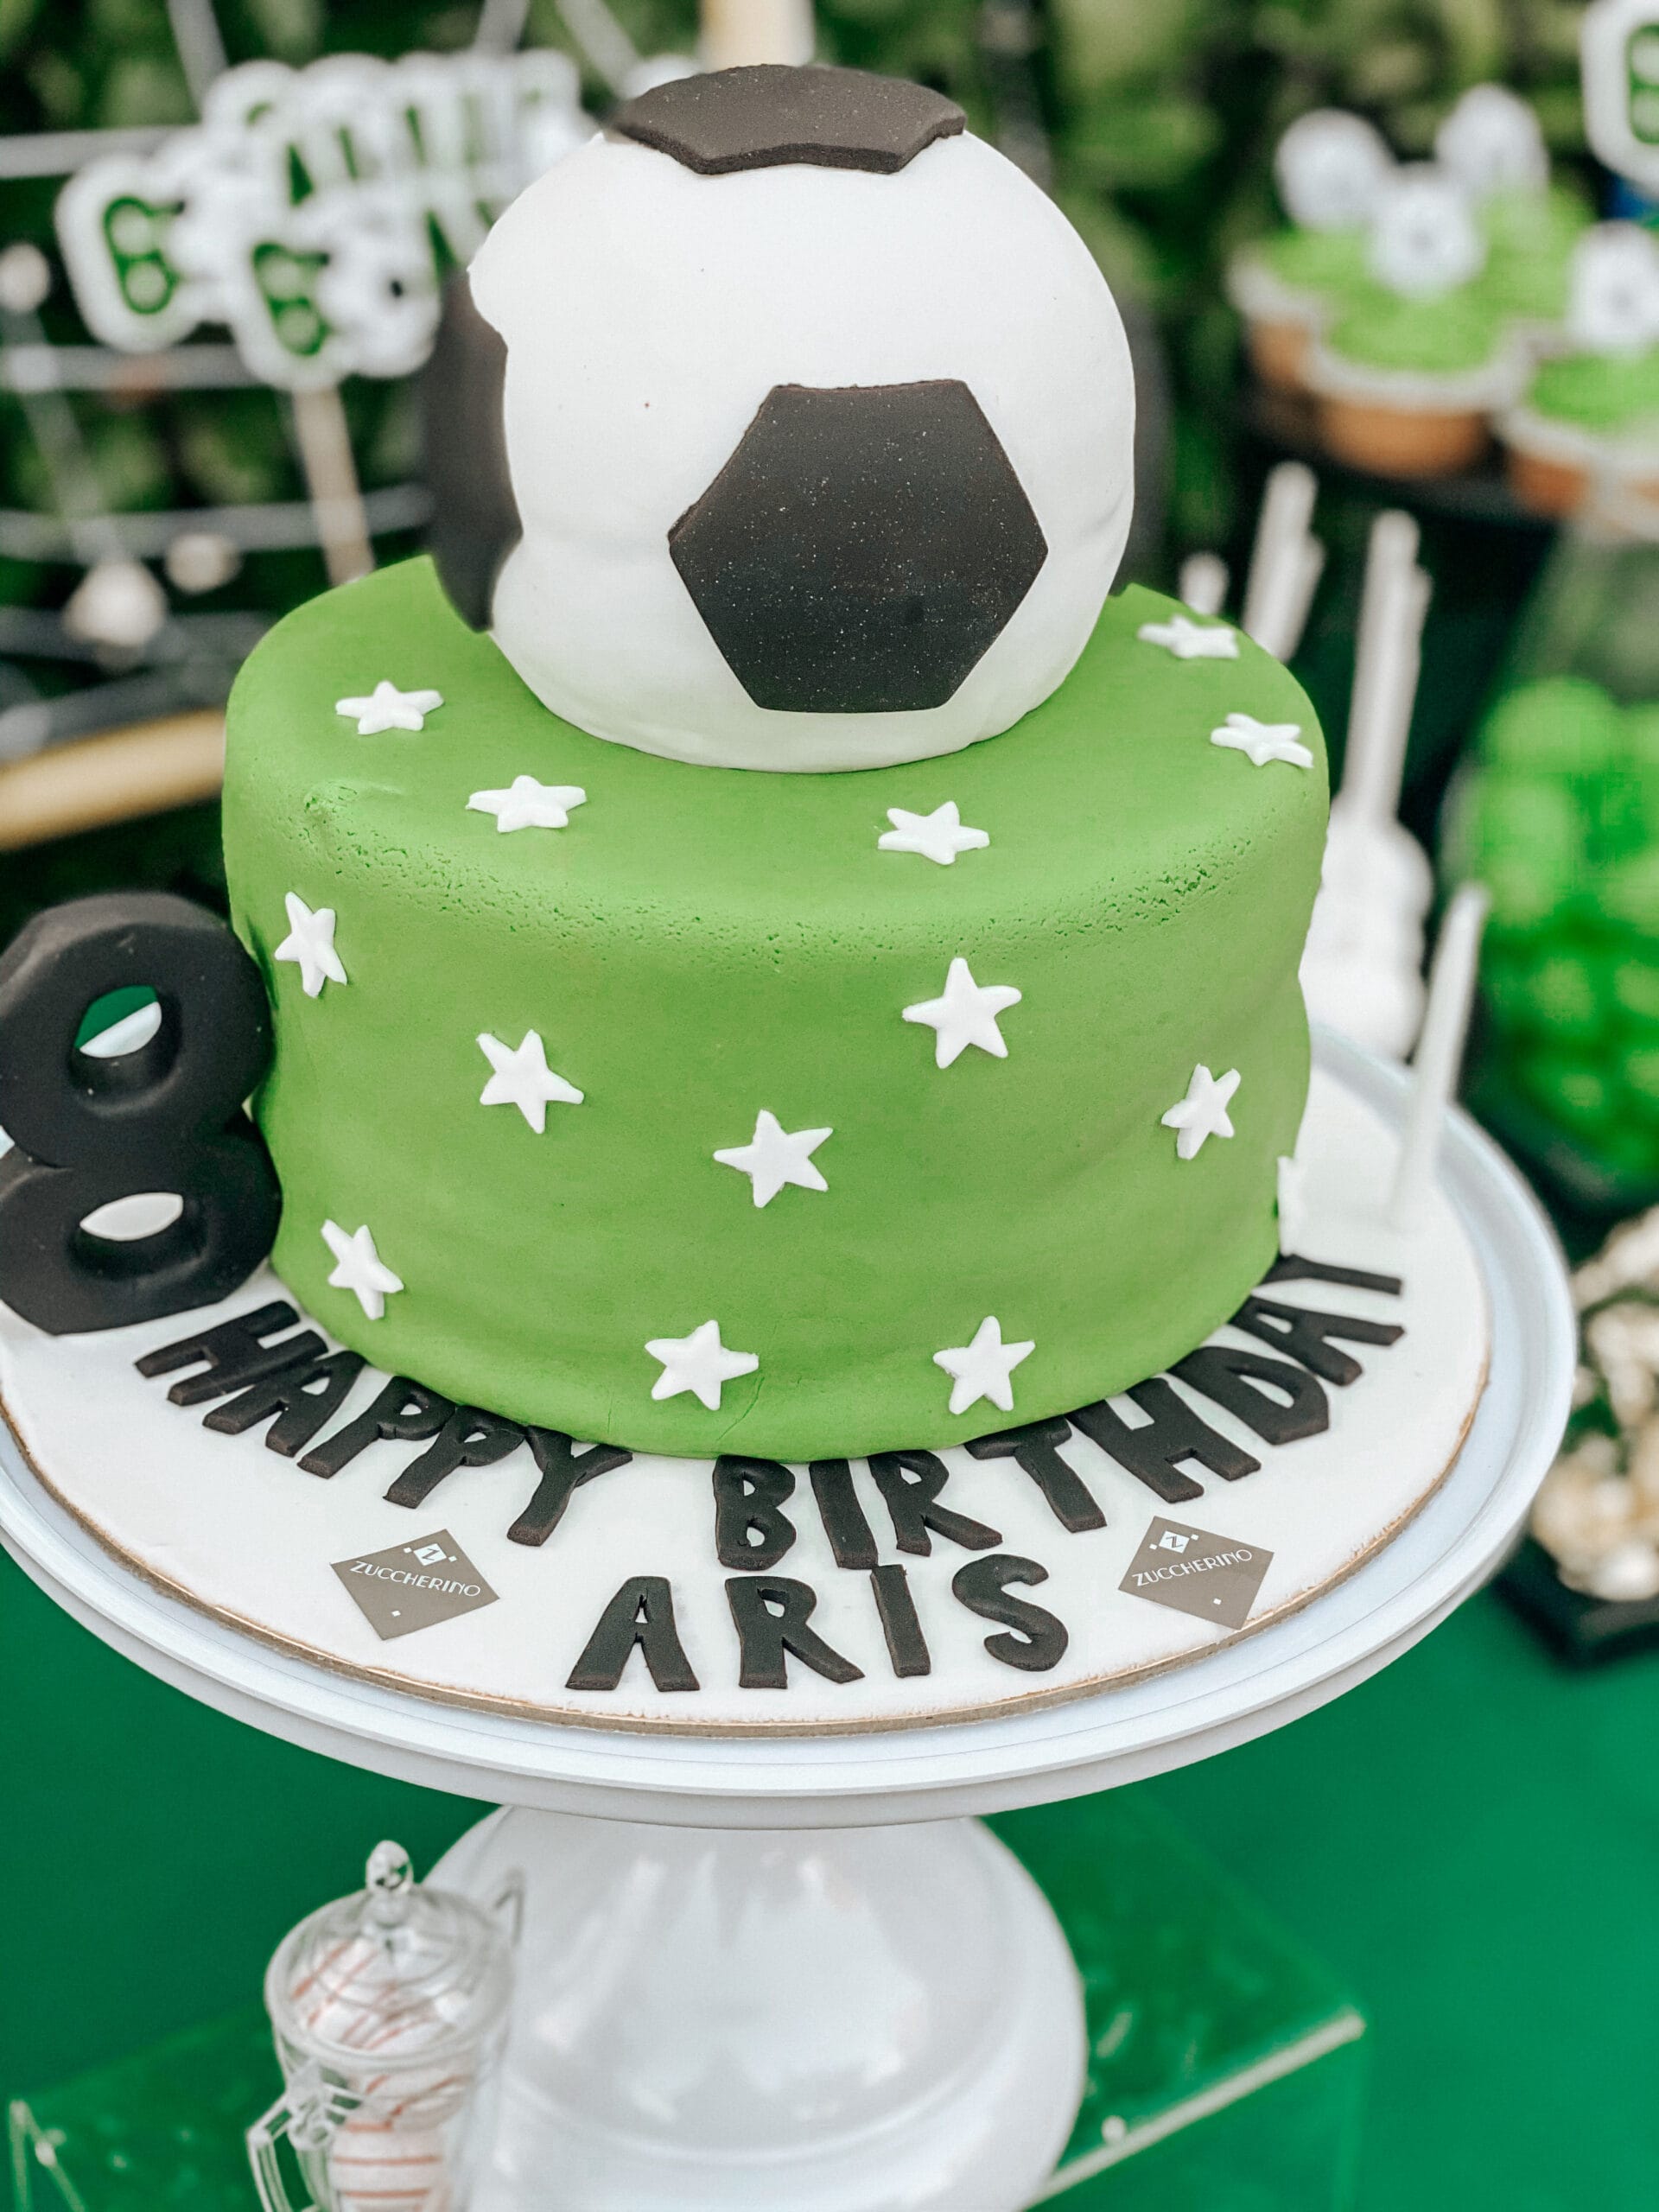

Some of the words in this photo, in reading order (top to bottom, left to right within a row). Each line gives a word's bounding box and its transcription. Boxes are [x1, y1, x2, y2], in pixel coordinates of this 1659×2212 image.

[0, 892, 283, 1336] 8
[133, 1300, 632, 1547] HAPPY
[711, 1253, 1406, 1571] BIRTHDAY
[349, 1560, 481, 1597] ZUCCHERINO
[565, 1554, 1070, 1692] ARIS
[1132, 1548, 1253, 1586] ZUCCHERINO
